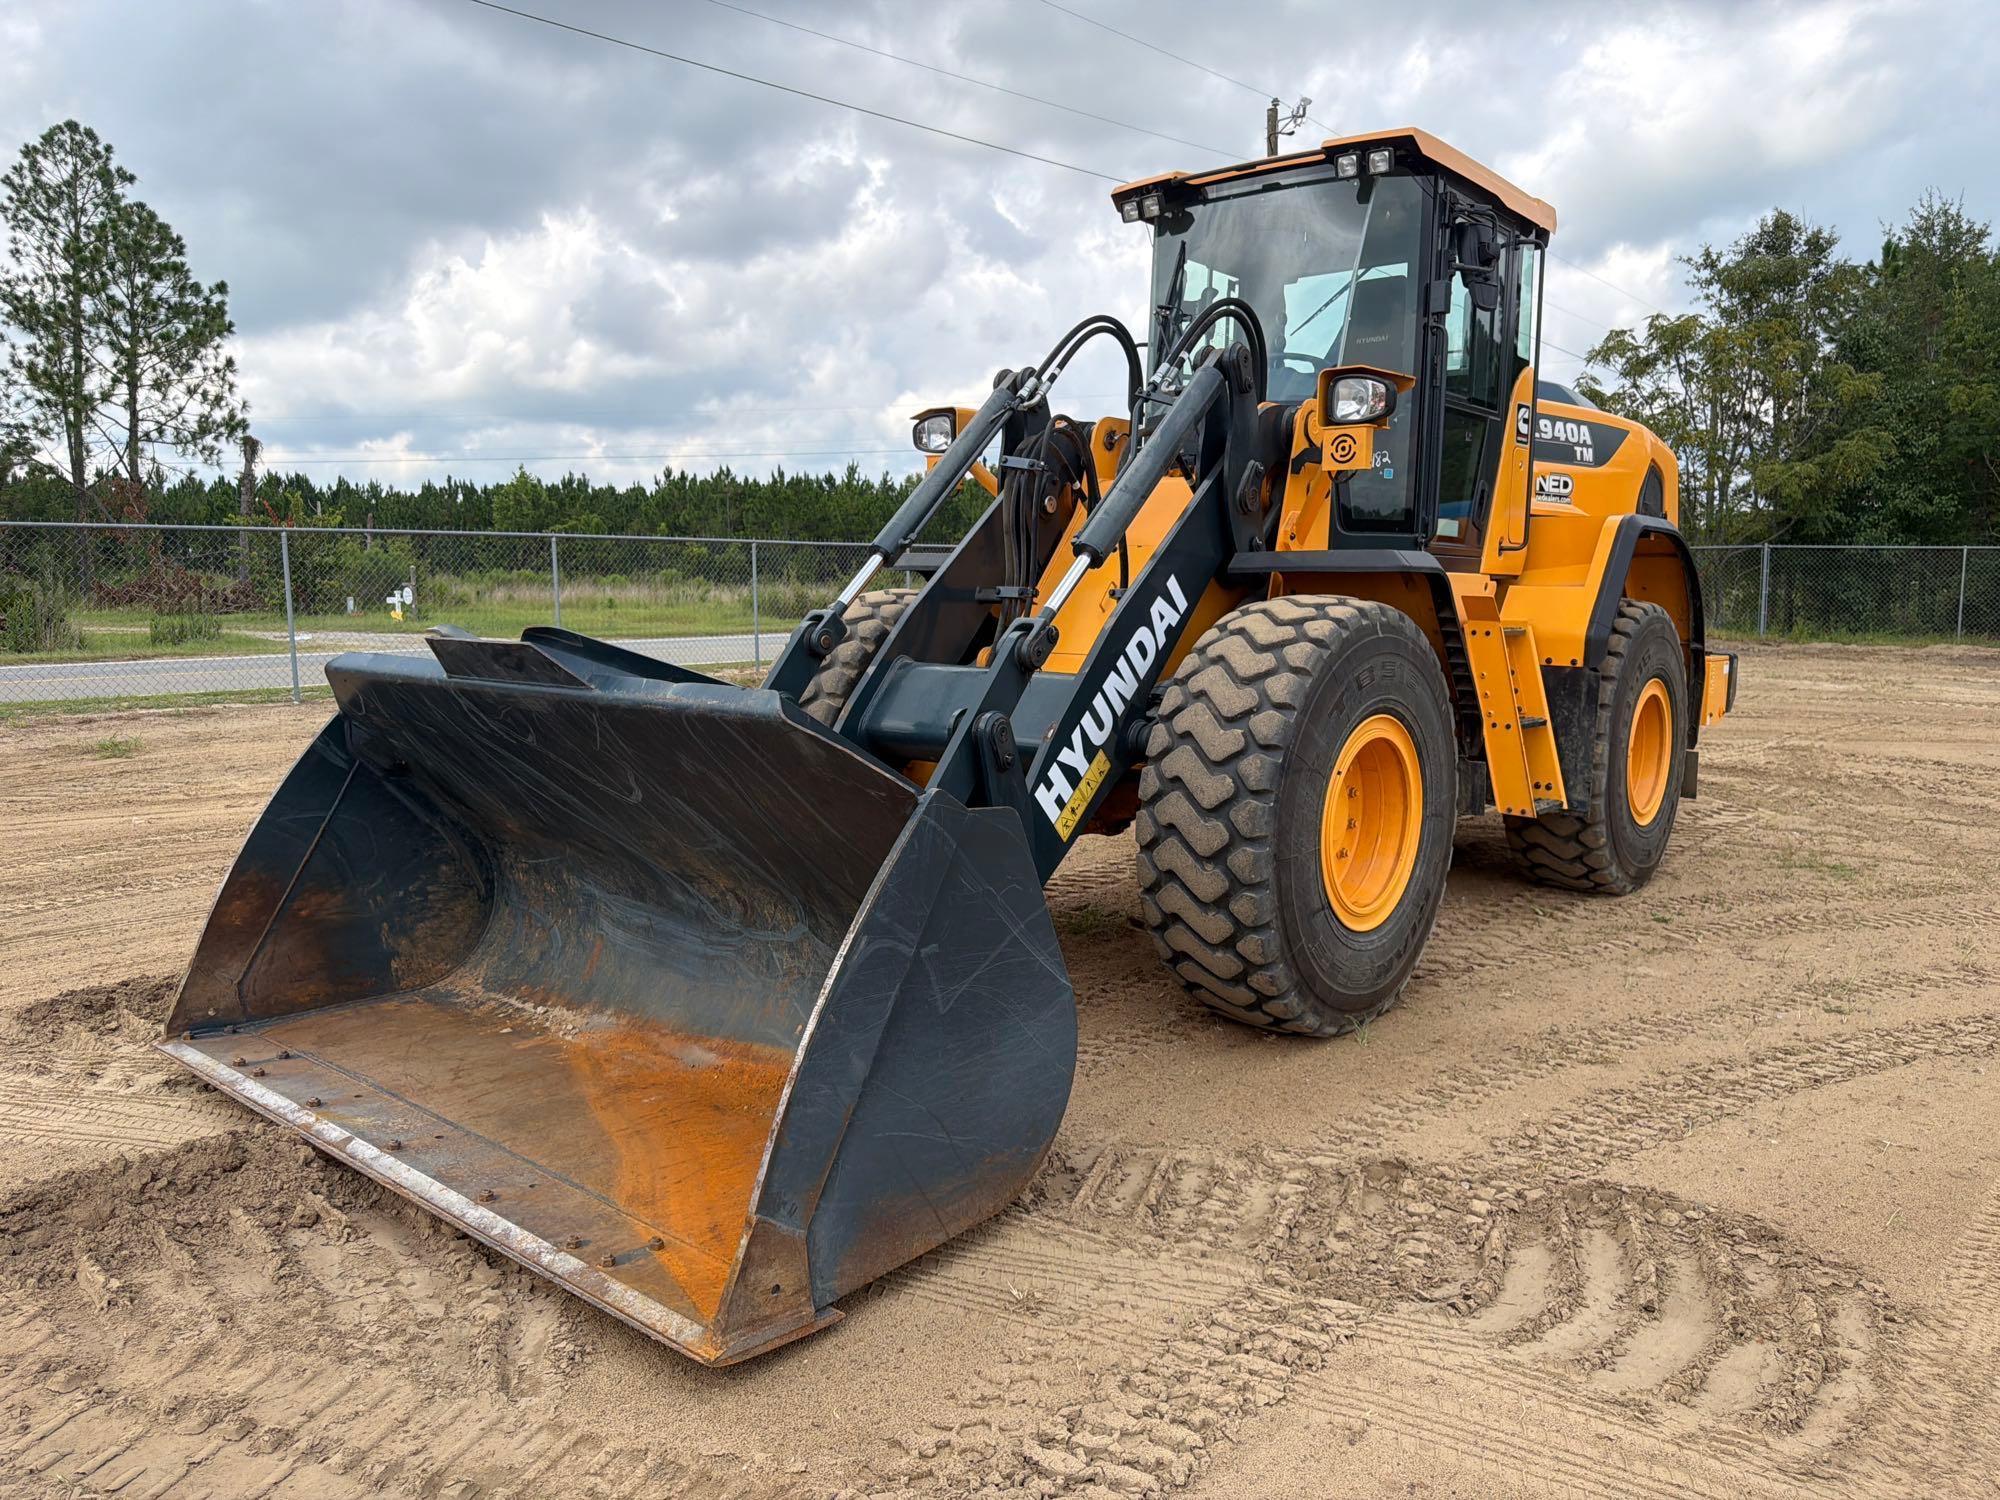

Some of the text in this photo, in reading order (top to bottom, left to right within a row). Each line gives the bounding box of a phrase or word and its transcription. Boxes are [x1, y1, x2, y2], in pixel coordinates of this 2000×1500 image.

[1573, 446, 1593, 463] TM
[1536, 474, 1573, 494] NED
[1034, 573, 1188, 825] HYUNDAI
